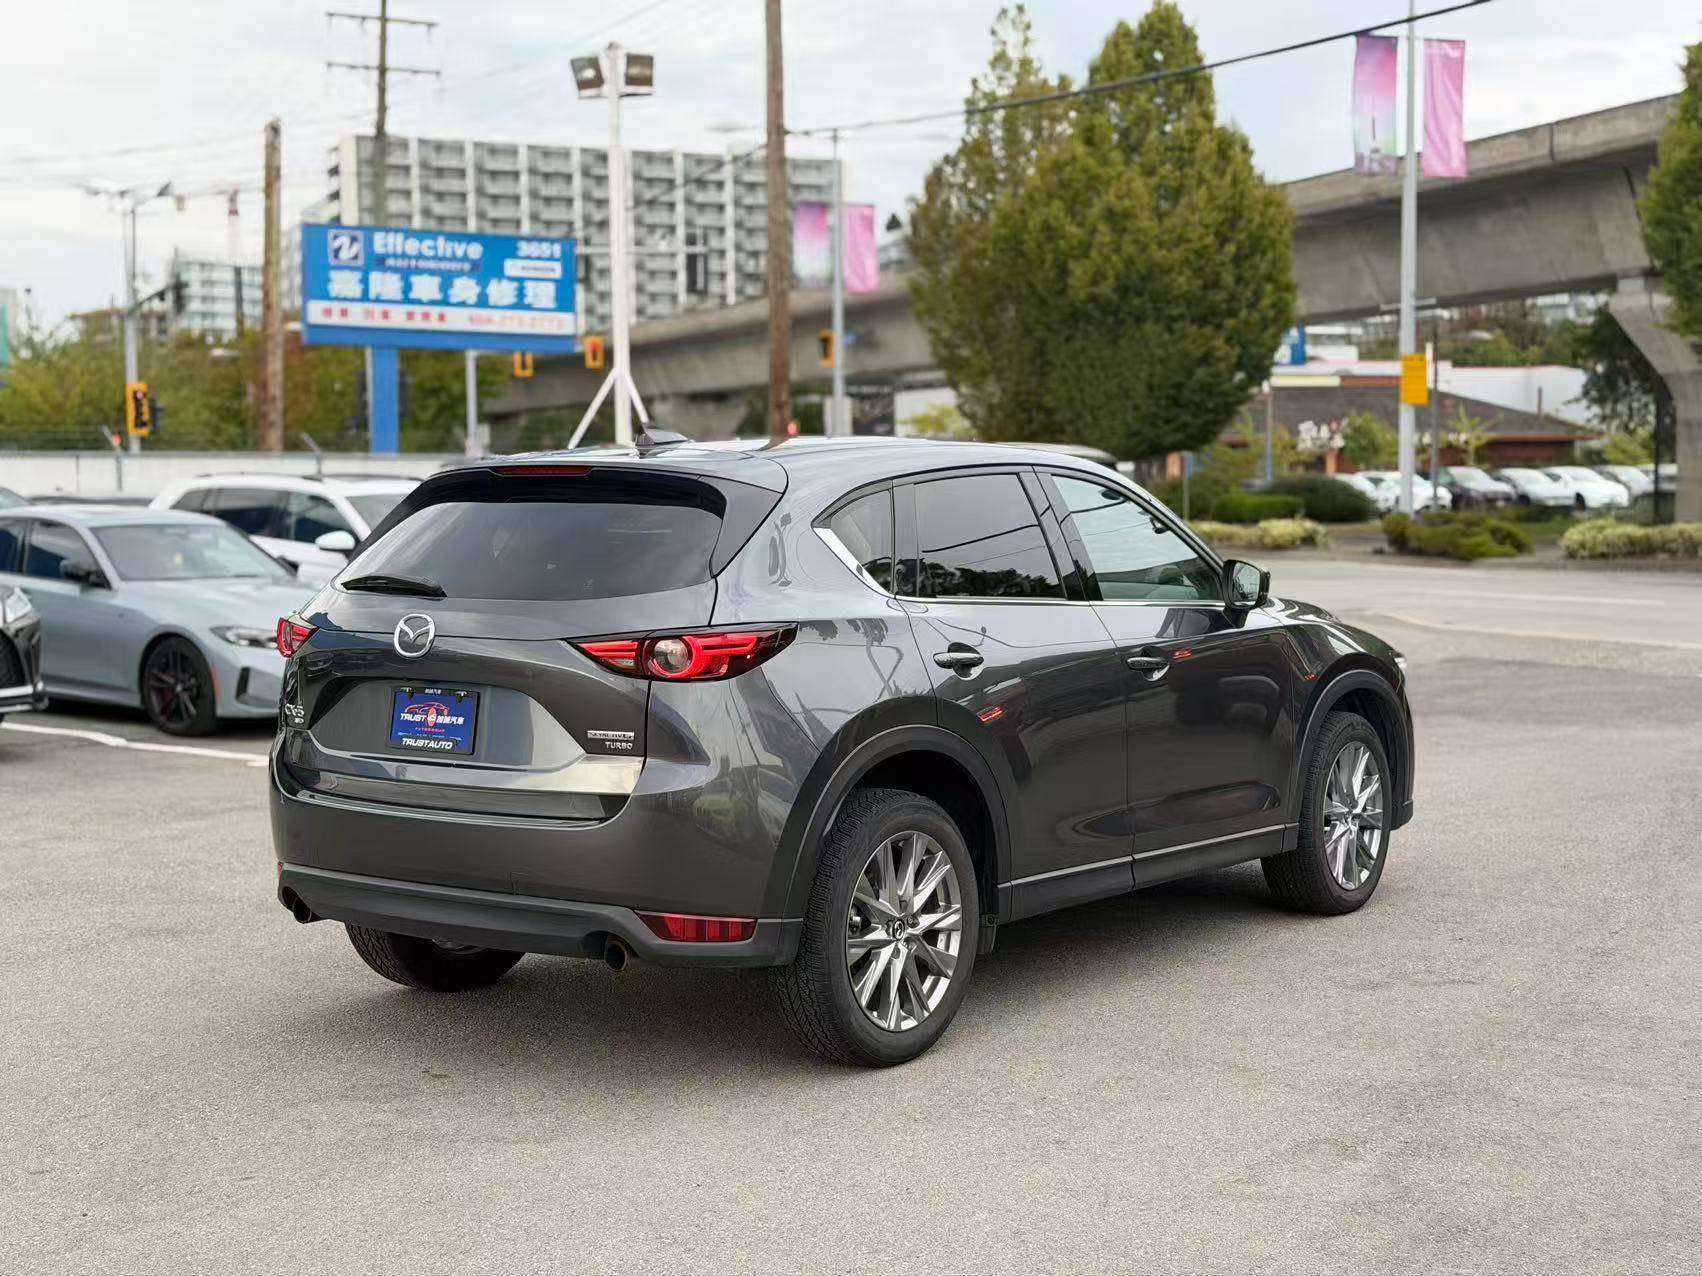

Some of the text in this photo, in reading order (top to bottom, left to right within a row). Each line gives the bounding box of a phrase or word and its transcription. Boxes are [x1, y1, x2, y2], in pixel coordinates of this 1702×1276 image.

[400, 713, 427, 722] TRUST
[402, 738, 453, 749] TRUSTAUTO
[605, 741, 633, 749] TURBO
